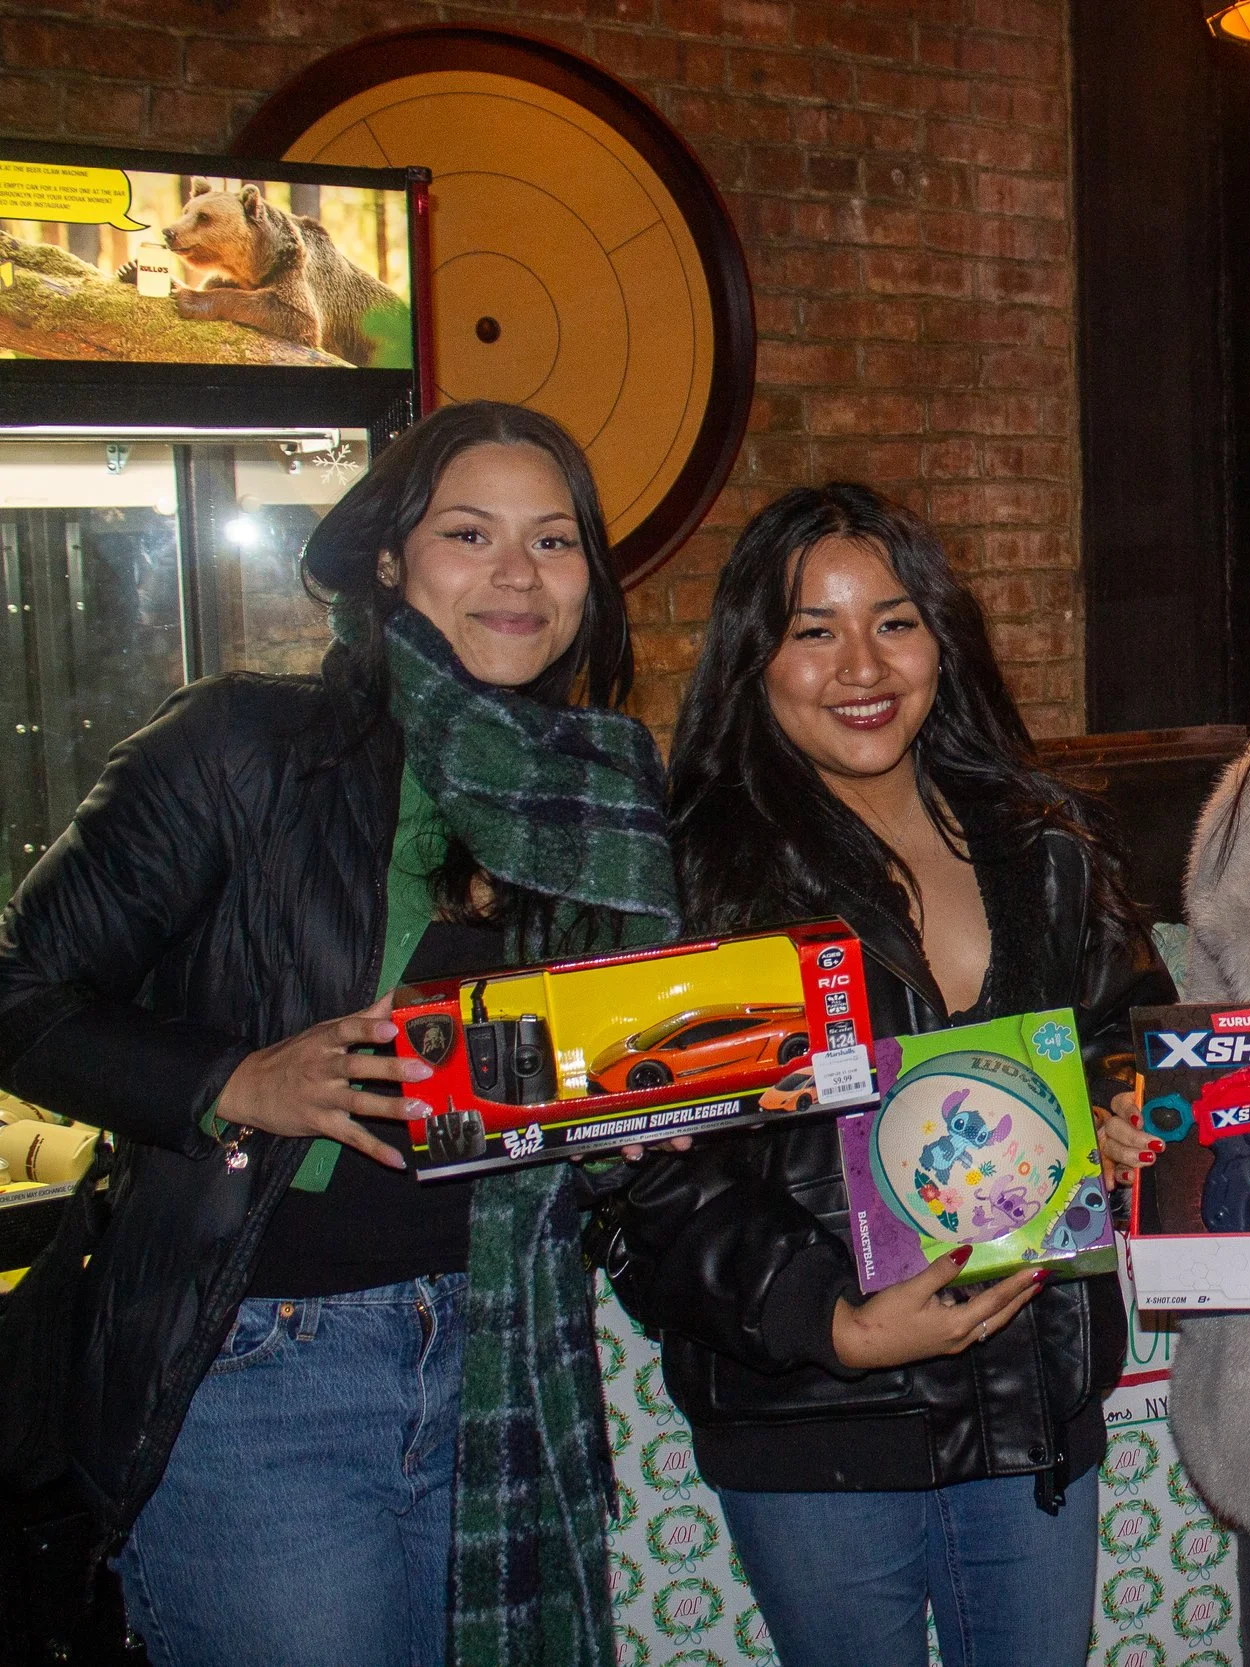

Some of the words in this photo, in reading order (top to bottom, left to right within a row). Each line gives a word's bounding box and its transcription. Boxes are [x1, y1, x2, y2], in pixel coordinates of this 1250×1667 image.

[821, 951, 841, 960] AGES
[823, 958, 839, 967] 6+
[818, 974, 850, 989] R/C
[829, 1032, 855, 1049] 1:24
[825, 1048, 856, 1059] Marshalls
[833, 1075, 852, 1085] $9.99
[566, 1115, 648, 1142] LAMBORGHINI
[650, 1100, 740, 1128] SUPERLEGGERA
[858, 1210, 875, 1280] BASKETBALL
[1198, 1296, 1210, 1304] 8+
[1105, 1408, 1133, 1422] ons
[662, 1450, 692, 1472] JOY
[1114, 1448, 1141, 1470] JOY
[668, 1523, 697, 1546] JOY
[1117, 1516, 1143, 1538] JOY
[1187, 1535, 1213, 1556] JOY
[1119, 1583, 1146, 1605] JOY
[673, 1596, 702, 1618] JOY
[1189, 1601, 1214, 1622] JOY
